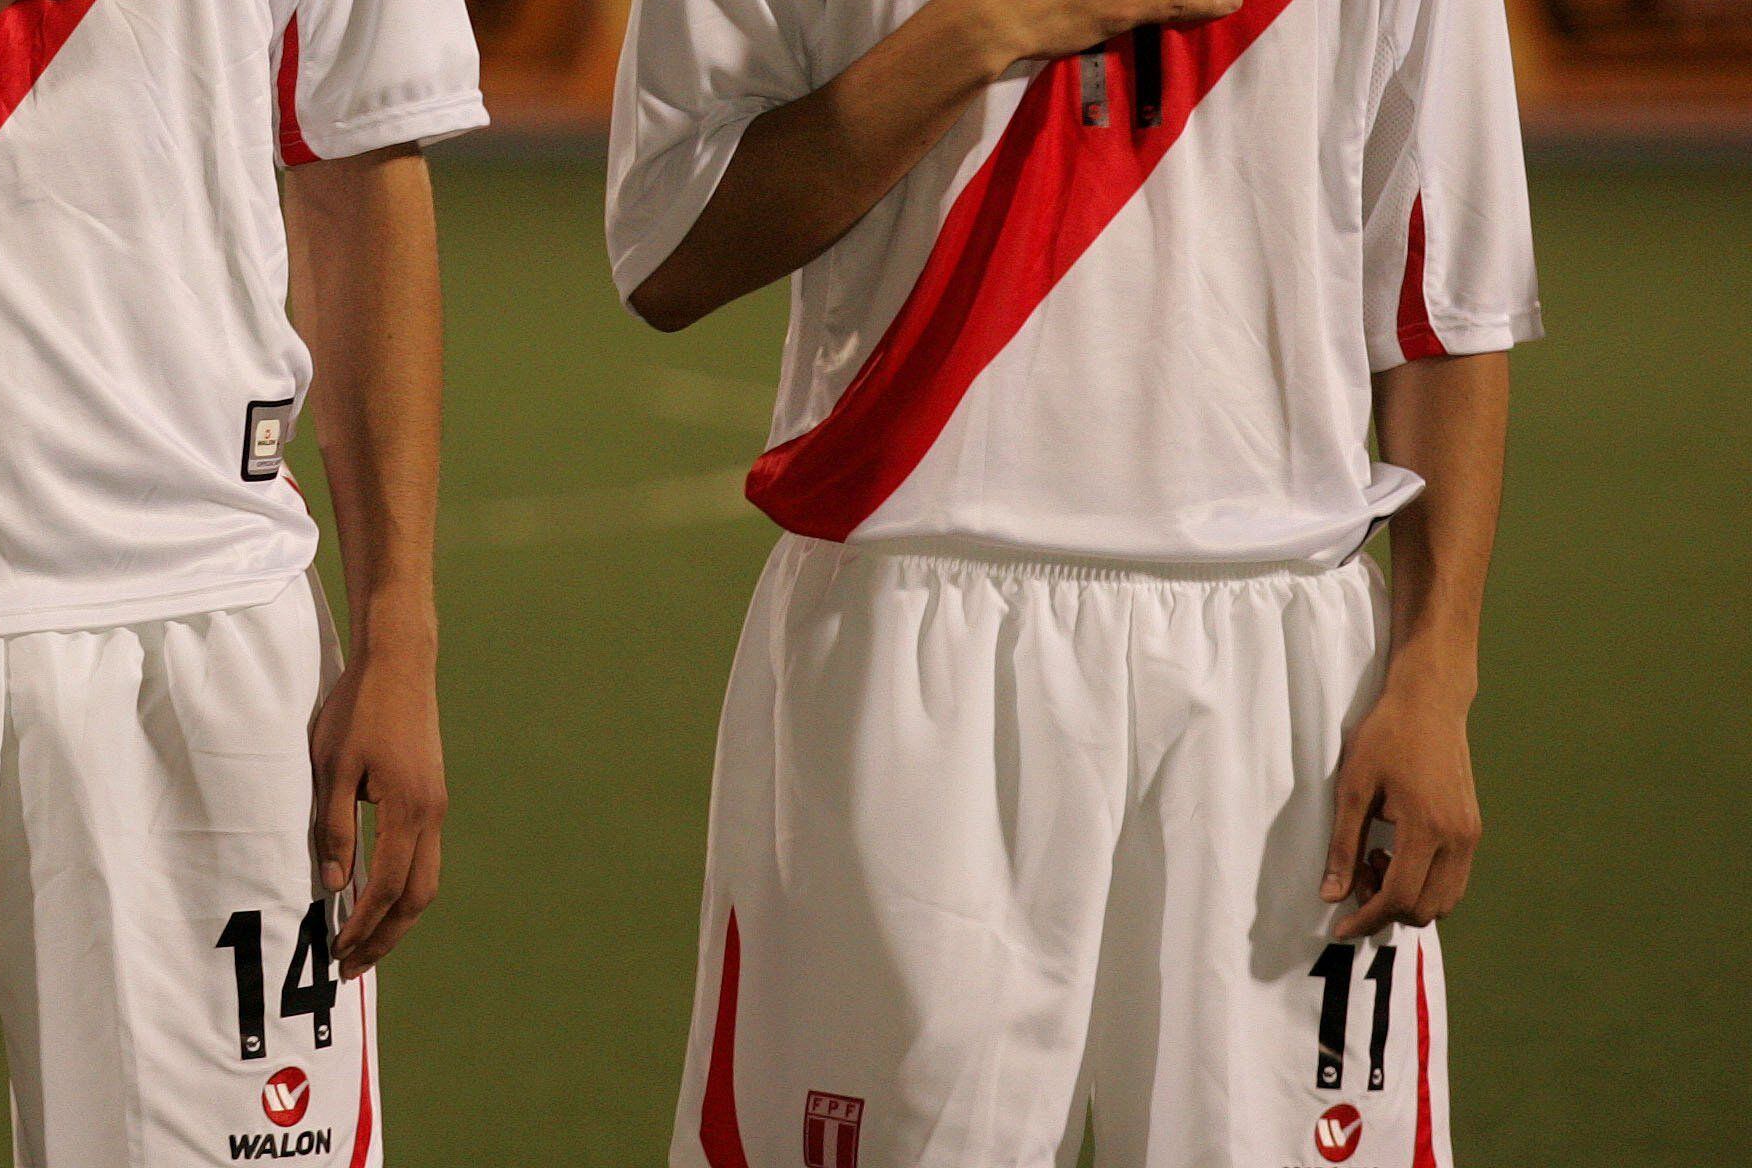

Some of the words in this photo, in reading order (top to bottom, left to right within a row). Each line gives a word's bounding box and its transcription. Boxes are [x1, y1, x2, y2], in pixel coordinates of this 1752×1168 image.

[215, 898, 339, 1062] 14
[1308, 942, 1398, 1092] 11
[228, 1127, 332, 1161] WALON
[812, 1097, 857, 1118] FPF
